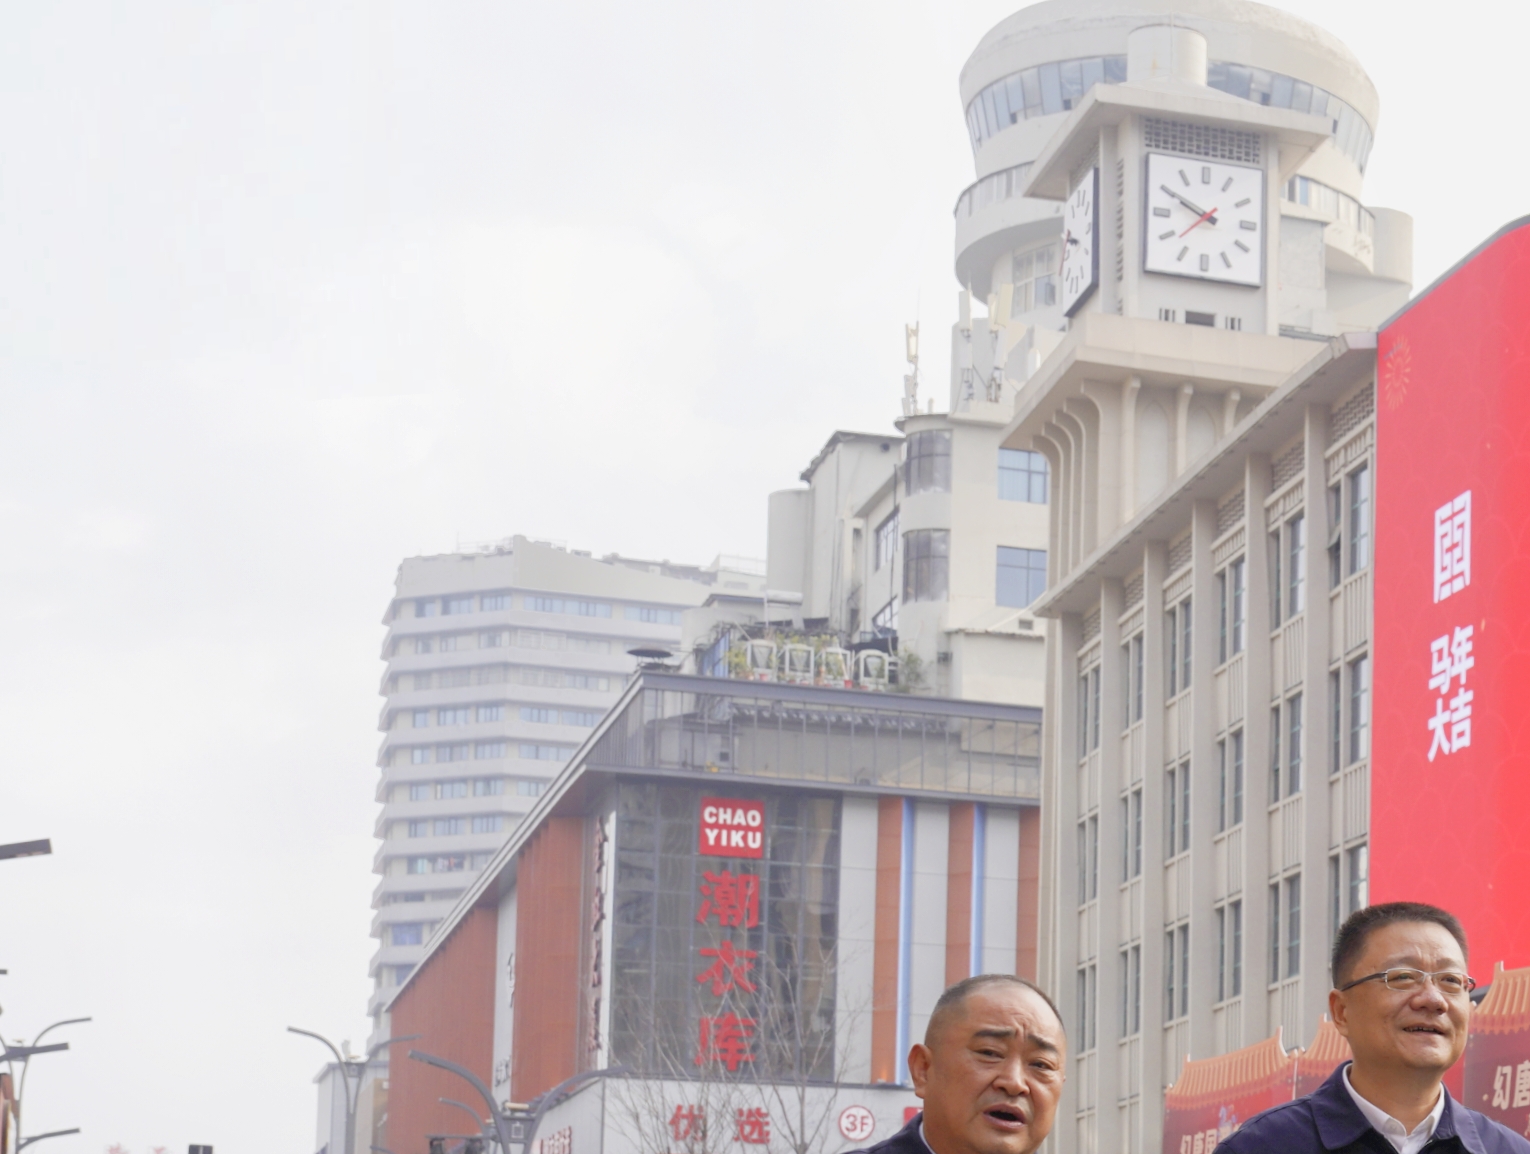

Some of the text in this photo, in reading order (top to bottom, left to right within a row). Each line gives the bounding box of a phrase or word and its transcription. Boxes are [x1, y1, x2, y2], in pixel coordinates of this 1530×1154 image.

[703, 806, 761, 827] CHAO
[704, 829, 762, 849] YIKU
[695, 869, 760, 1072] 潮衣库
[669, 1103, 770, 1144] 优选
[844, 1112, 870, 1135] 3F
